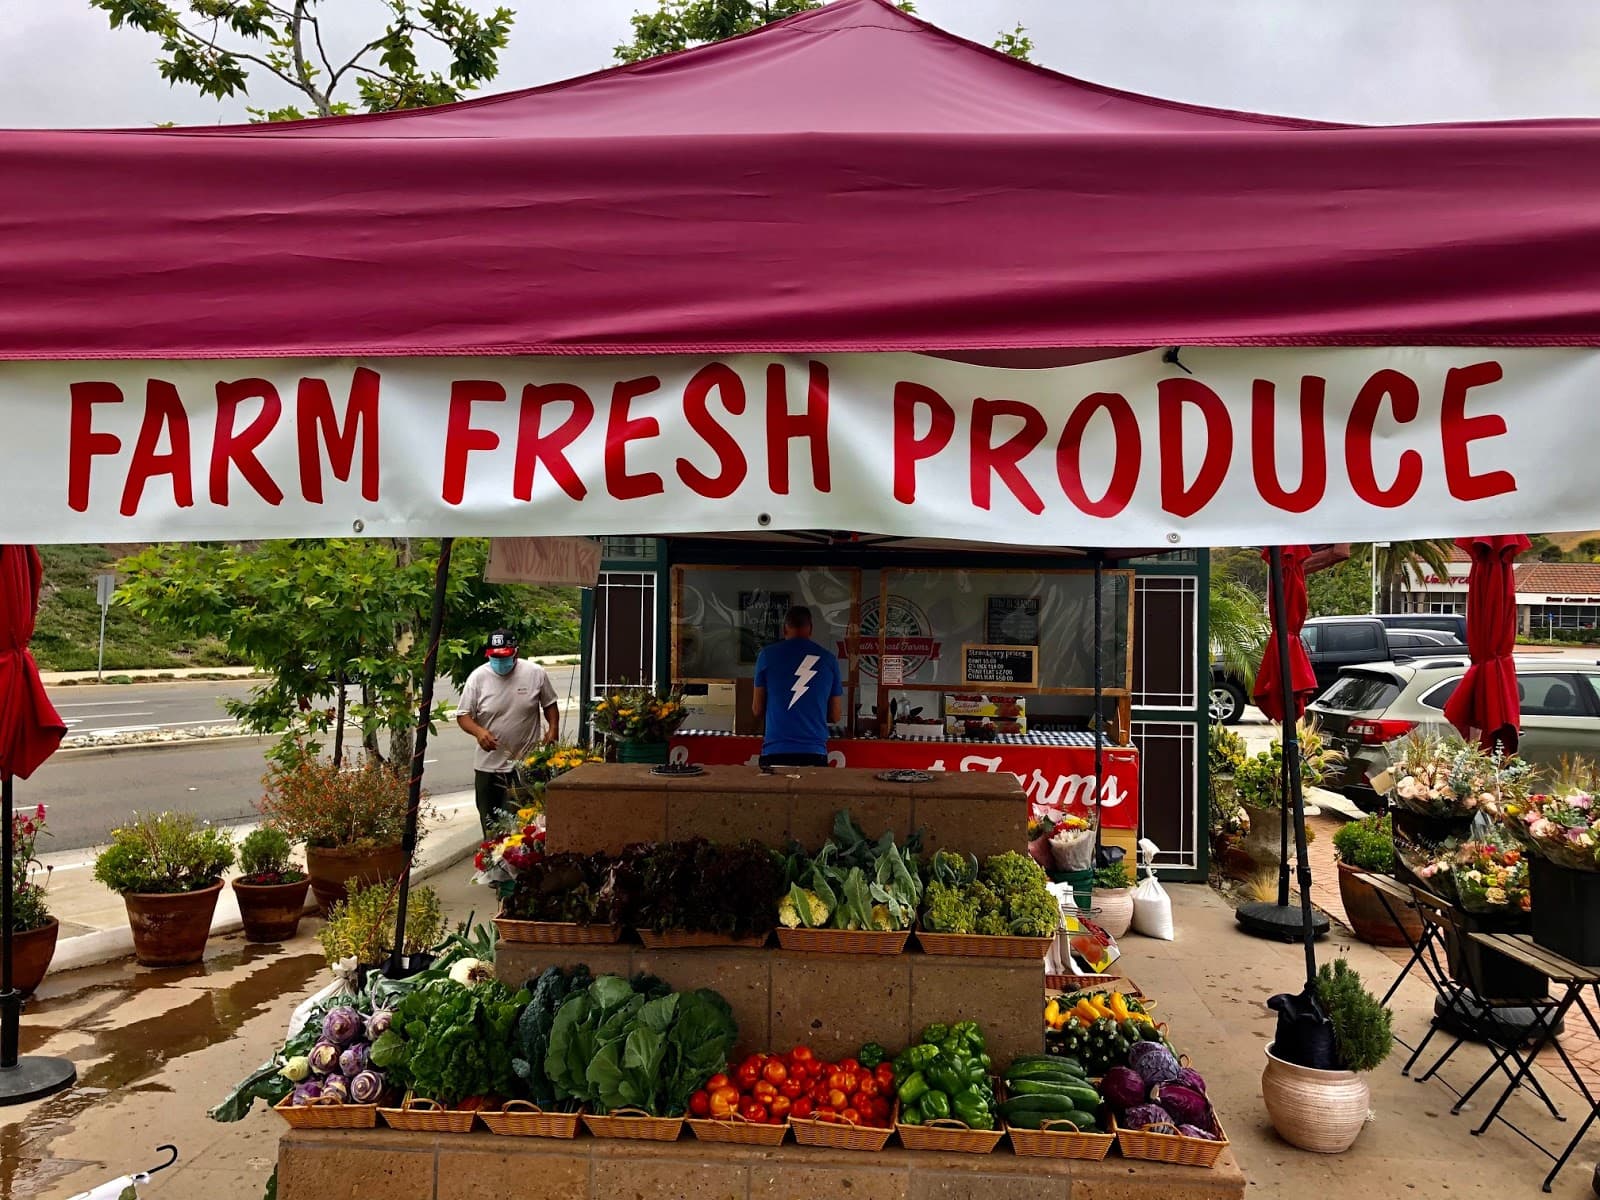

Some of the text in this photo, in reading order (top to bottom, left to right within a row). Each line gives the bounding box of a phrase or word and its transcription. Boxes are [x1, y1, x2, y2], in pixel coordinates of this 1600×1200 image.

[68, 361, 1517, 519] FARM FRESH PRODUCE
